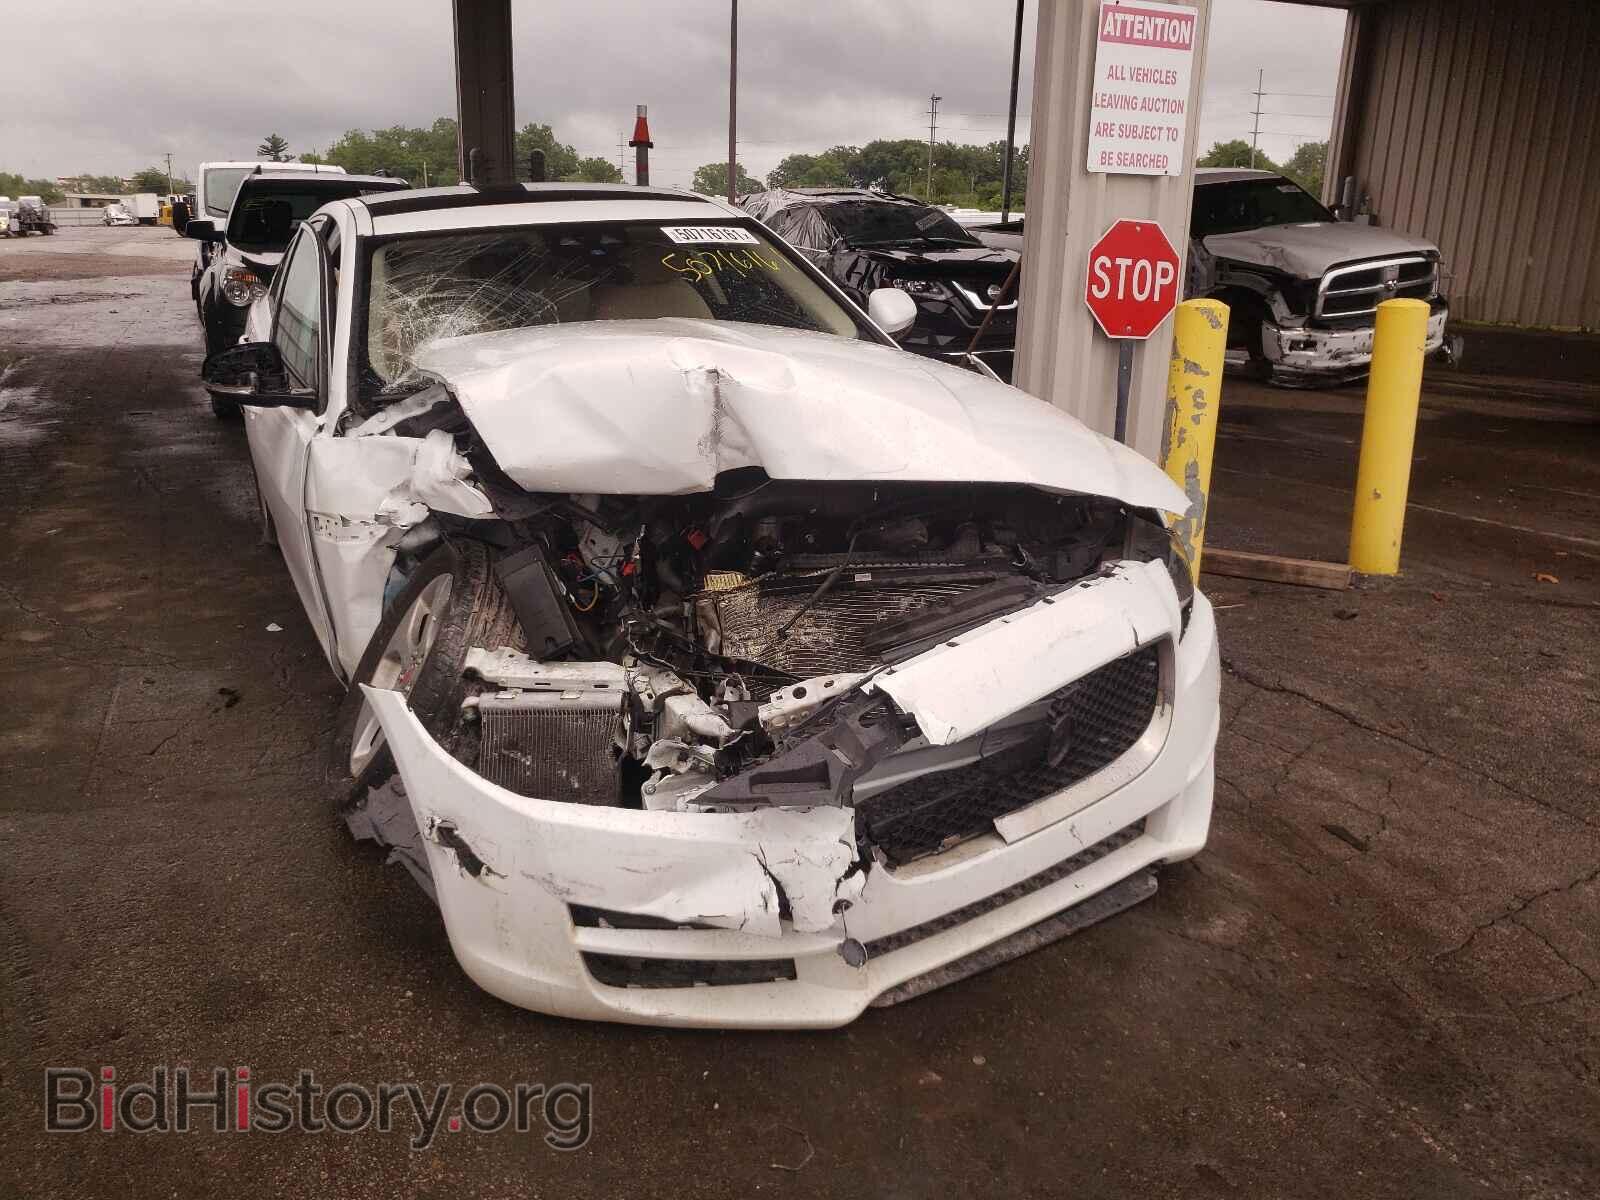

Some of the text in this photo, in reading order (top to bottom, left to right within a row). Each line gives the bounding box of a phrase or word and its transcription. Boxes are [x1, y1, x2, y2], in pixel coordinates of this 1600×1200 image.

[1103, 11, 1191, 44] ATTENTION
[1107, 65, 1177, 85] ALL VEHICLES
[1095, 93, 1184, 114] LEAVING AUCTION
[1095, 122, 1178, 141] ARE SUBJECT TO
[1100, 151, 1168, 168] BE SEARCHED
[1091, 255, 1175, 302] STOP
